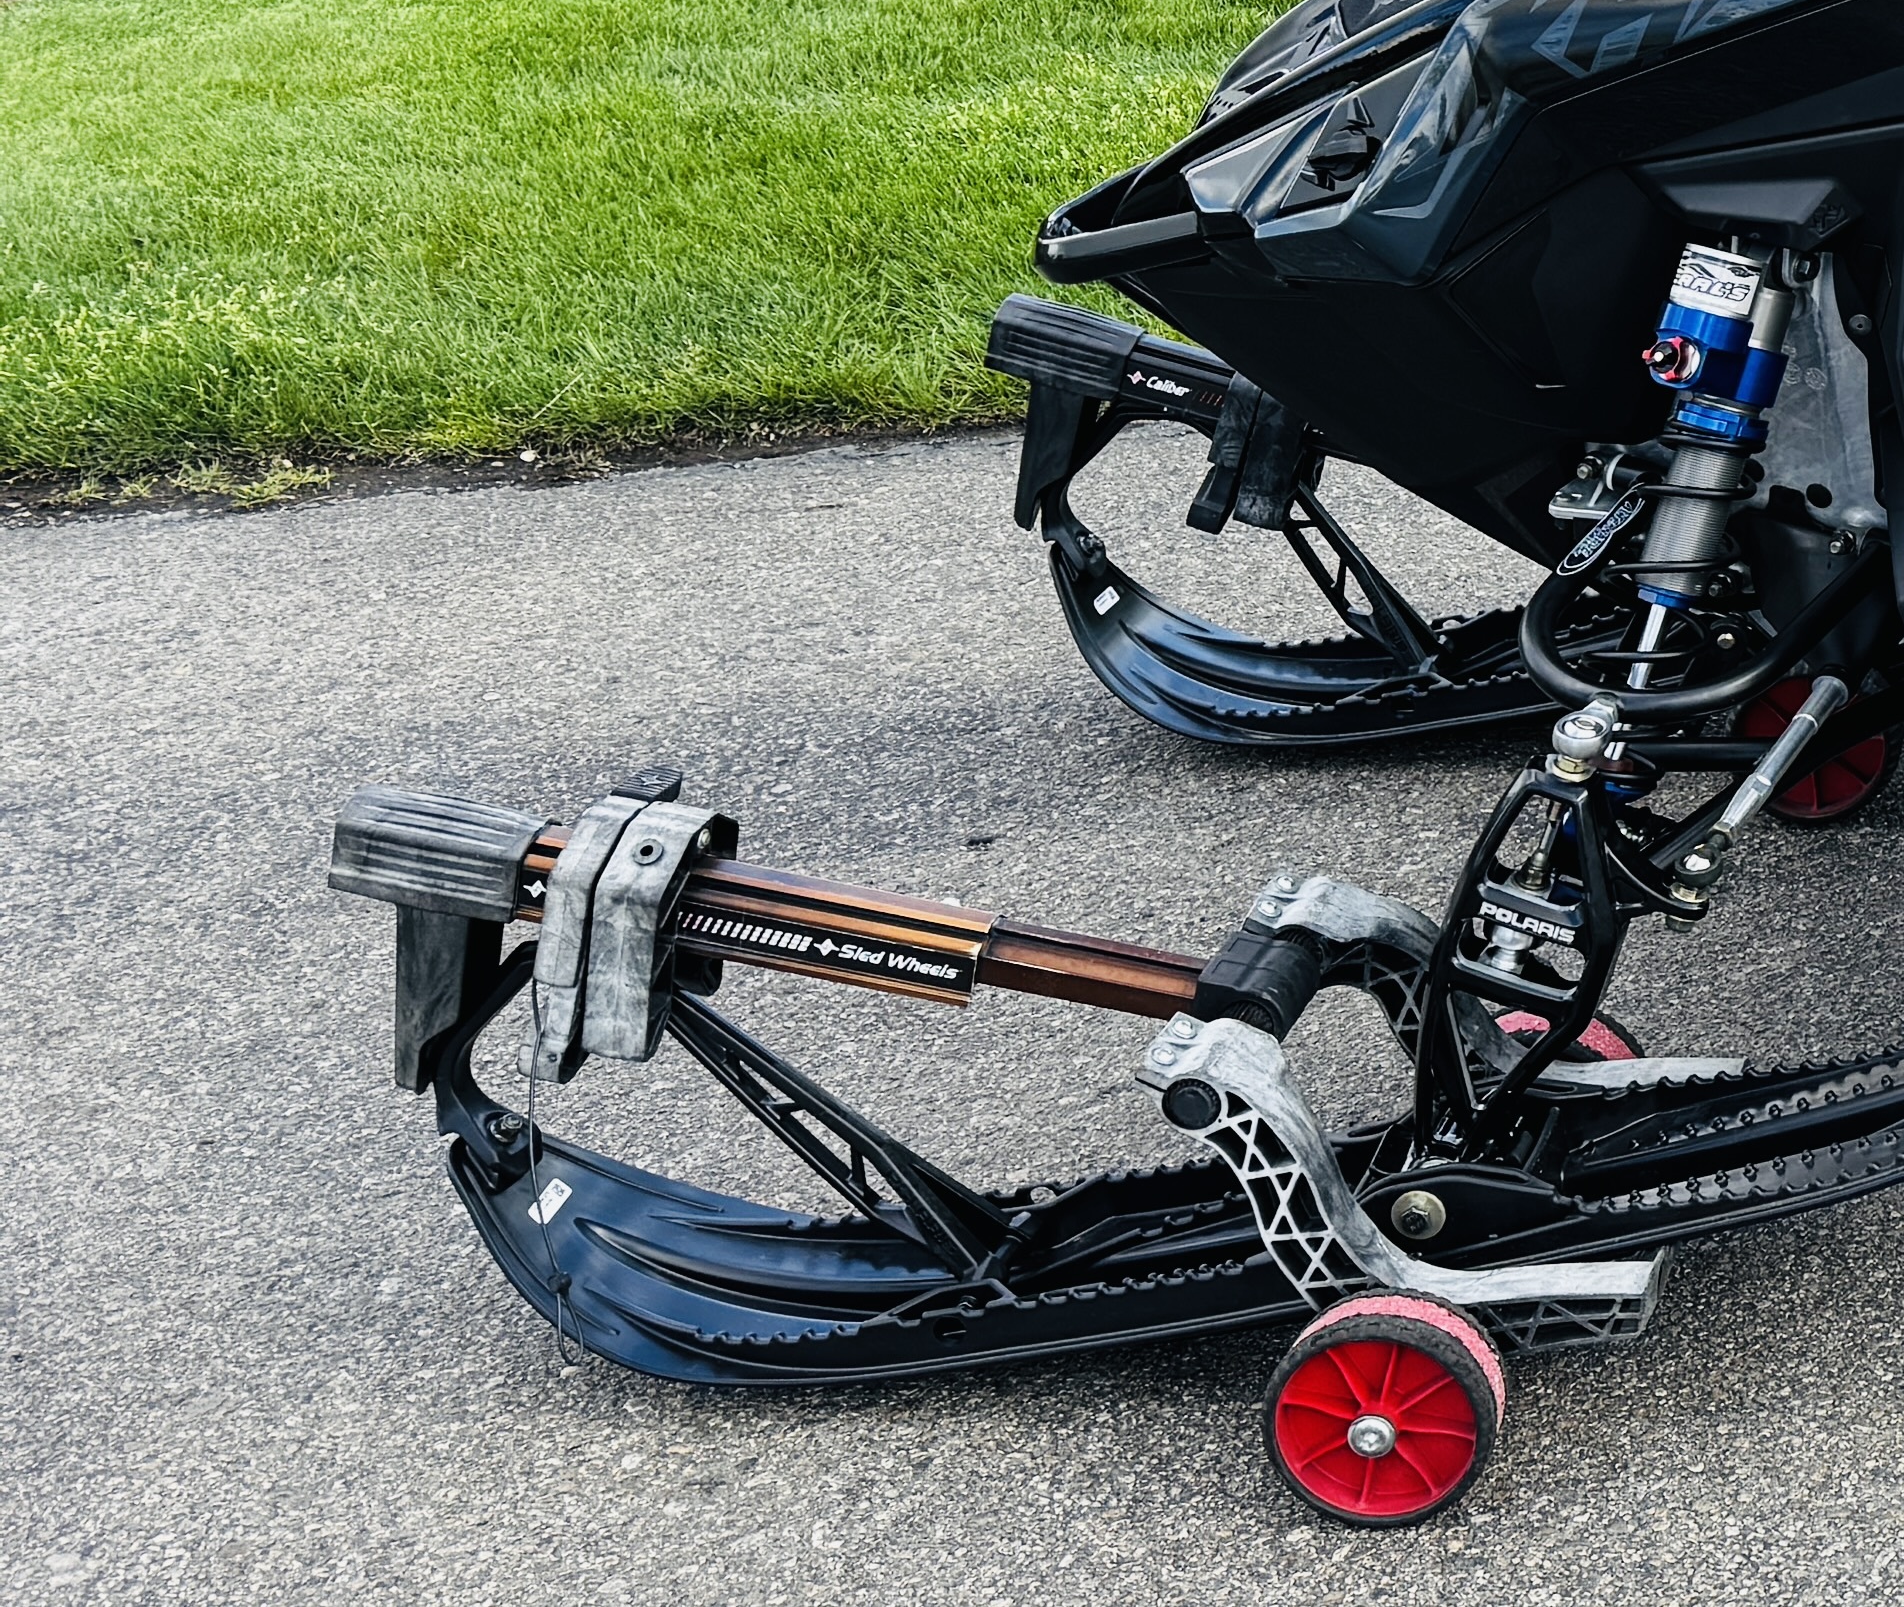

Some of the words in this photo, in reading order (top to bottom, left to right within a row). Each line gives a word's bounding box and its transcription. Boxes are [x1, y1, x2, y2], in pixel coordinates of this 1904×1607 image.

[1146, 376, 1190, 397] Caliber
[1479, 901, 1576, 945] POLARIS
[838, 944, 886, 965] Sled
[887, 952, 960, 980] Wheels
